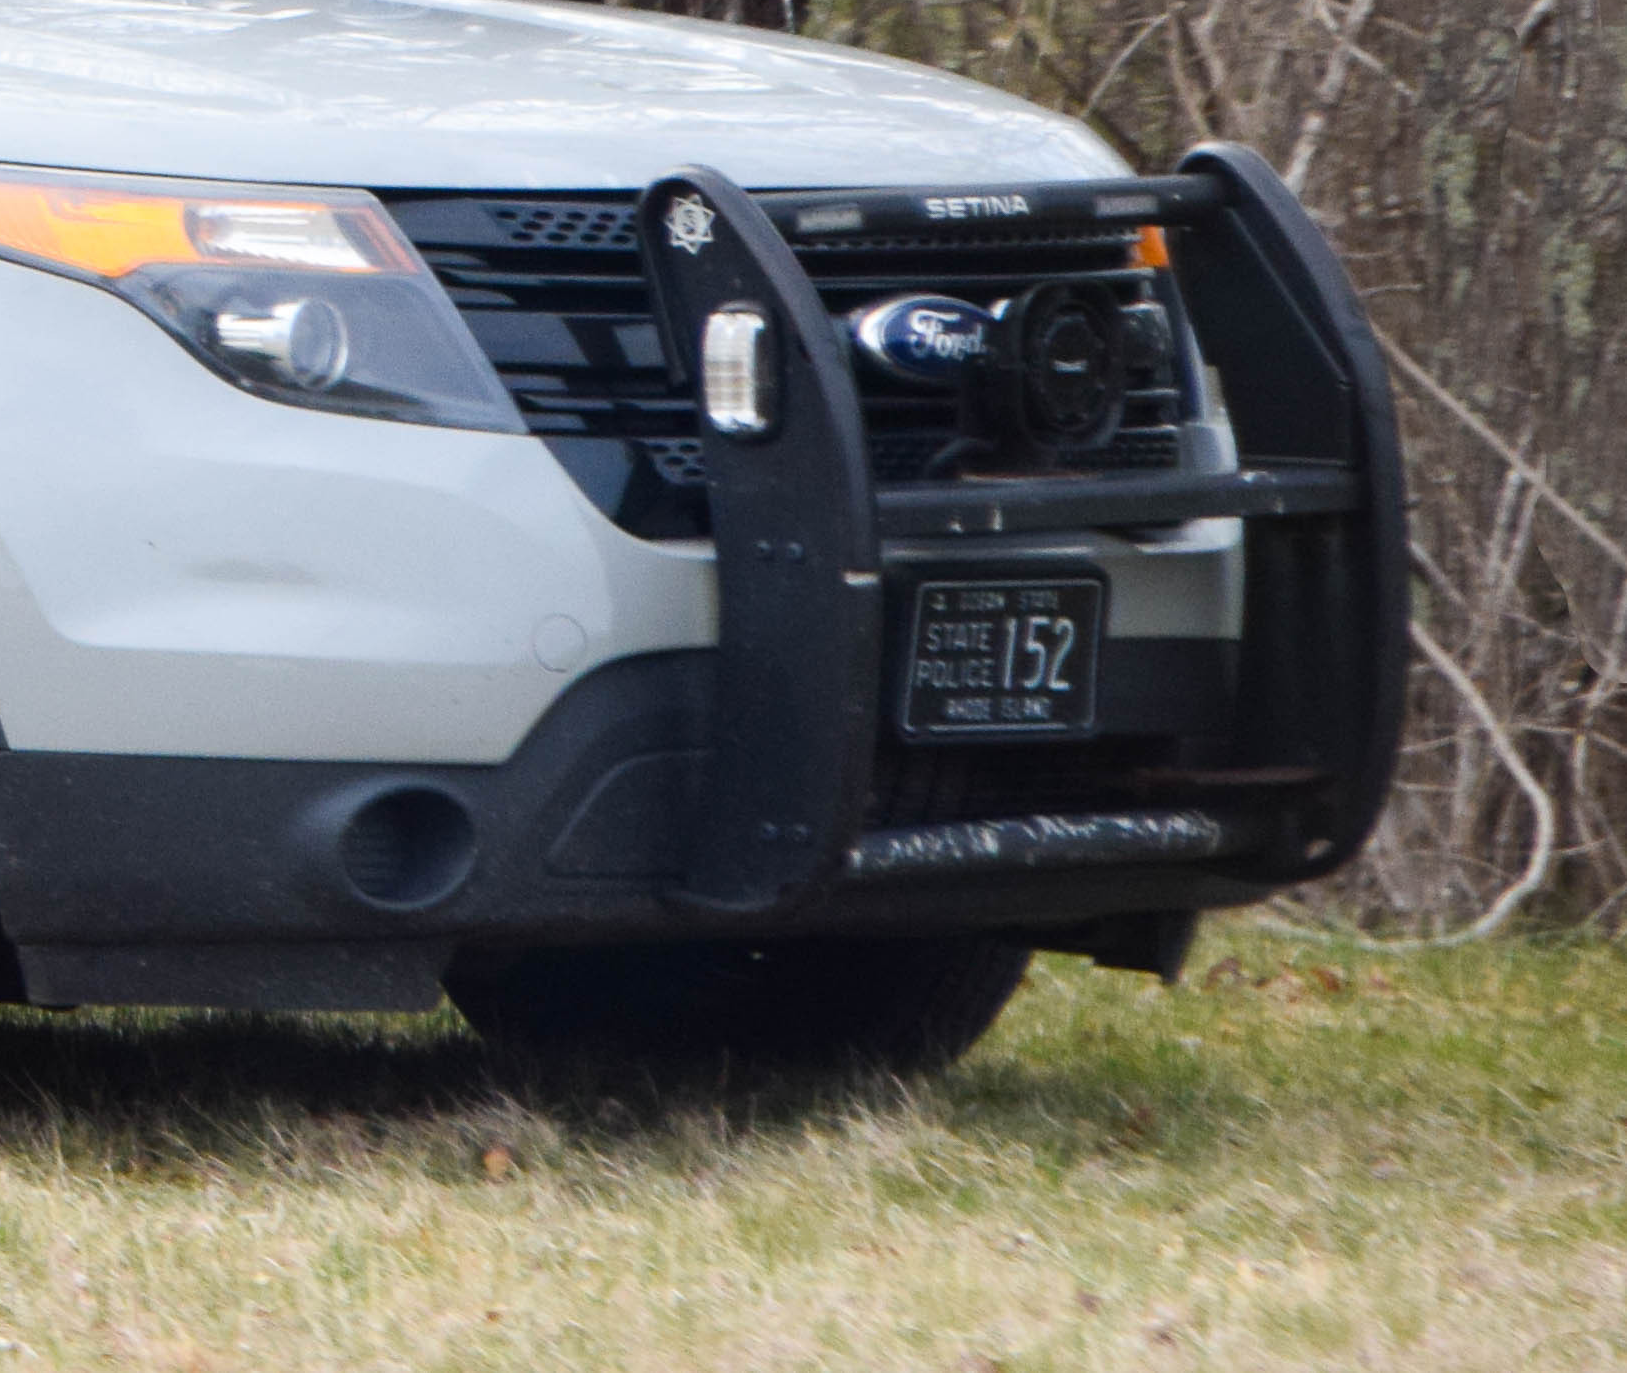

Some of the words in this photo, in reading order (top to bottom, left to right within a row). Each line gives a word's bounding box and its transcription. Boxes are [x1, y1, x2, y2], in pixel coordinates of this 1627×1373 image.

[923, 194, 1031, 220] SETINA
[906, 309, 985, 362] Ford
[926, 621, 994, 652] STATE
[1003, 616, 1076, 692] 152
[915, 658, 995, 690] POLICE
